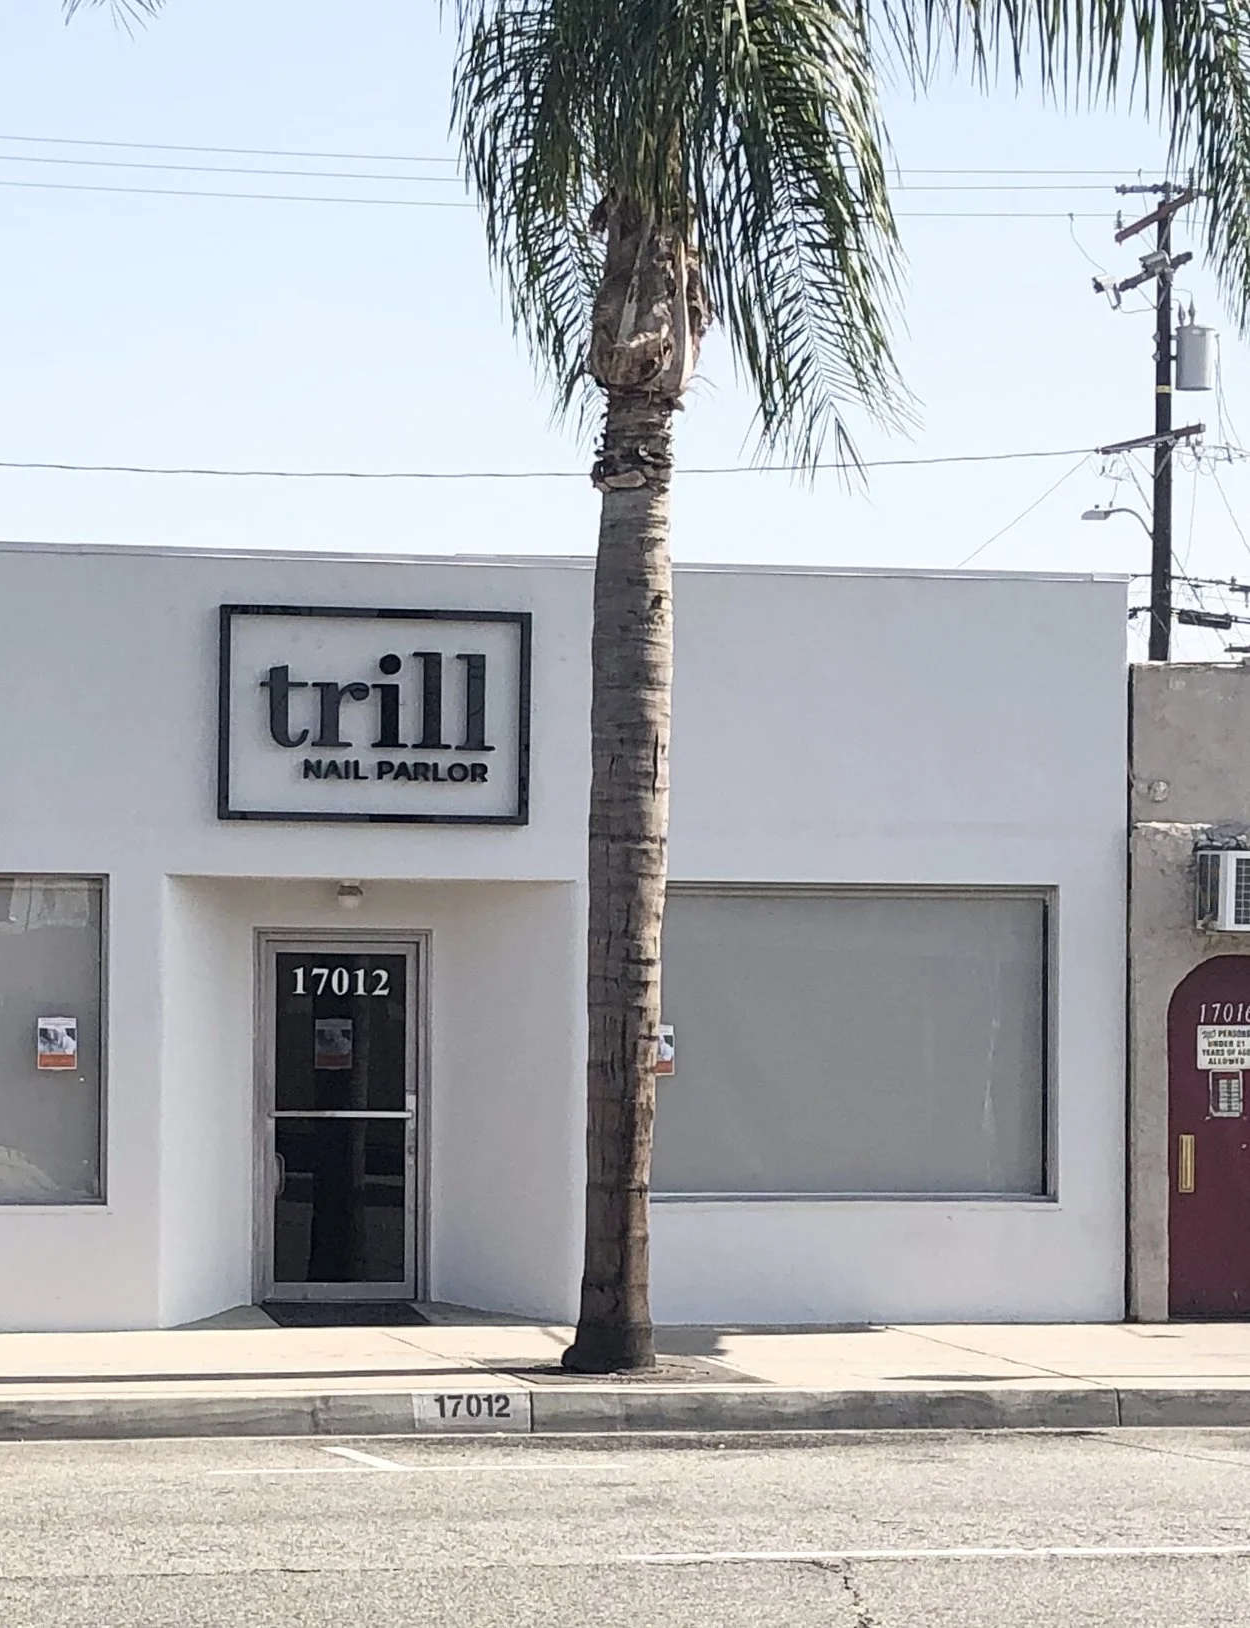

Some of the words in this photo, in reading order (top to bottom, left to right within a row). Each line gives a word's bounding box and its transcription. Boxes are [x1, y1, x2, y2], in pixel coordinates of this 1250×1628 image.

[260, 651, 496, 751] trill
[303, 758, 369, 780] NAIL
[376, 760, 489, 783] PARLOR
[292, 966, 390, 996] 17012
[1207, 1040, 1234, 1048] UNDER
[1236, 1040, 1245, 1048] 21
[1208, 1057, 1245, 1065] ALLOWED
[434, 1394, 511, 1418] 17012
